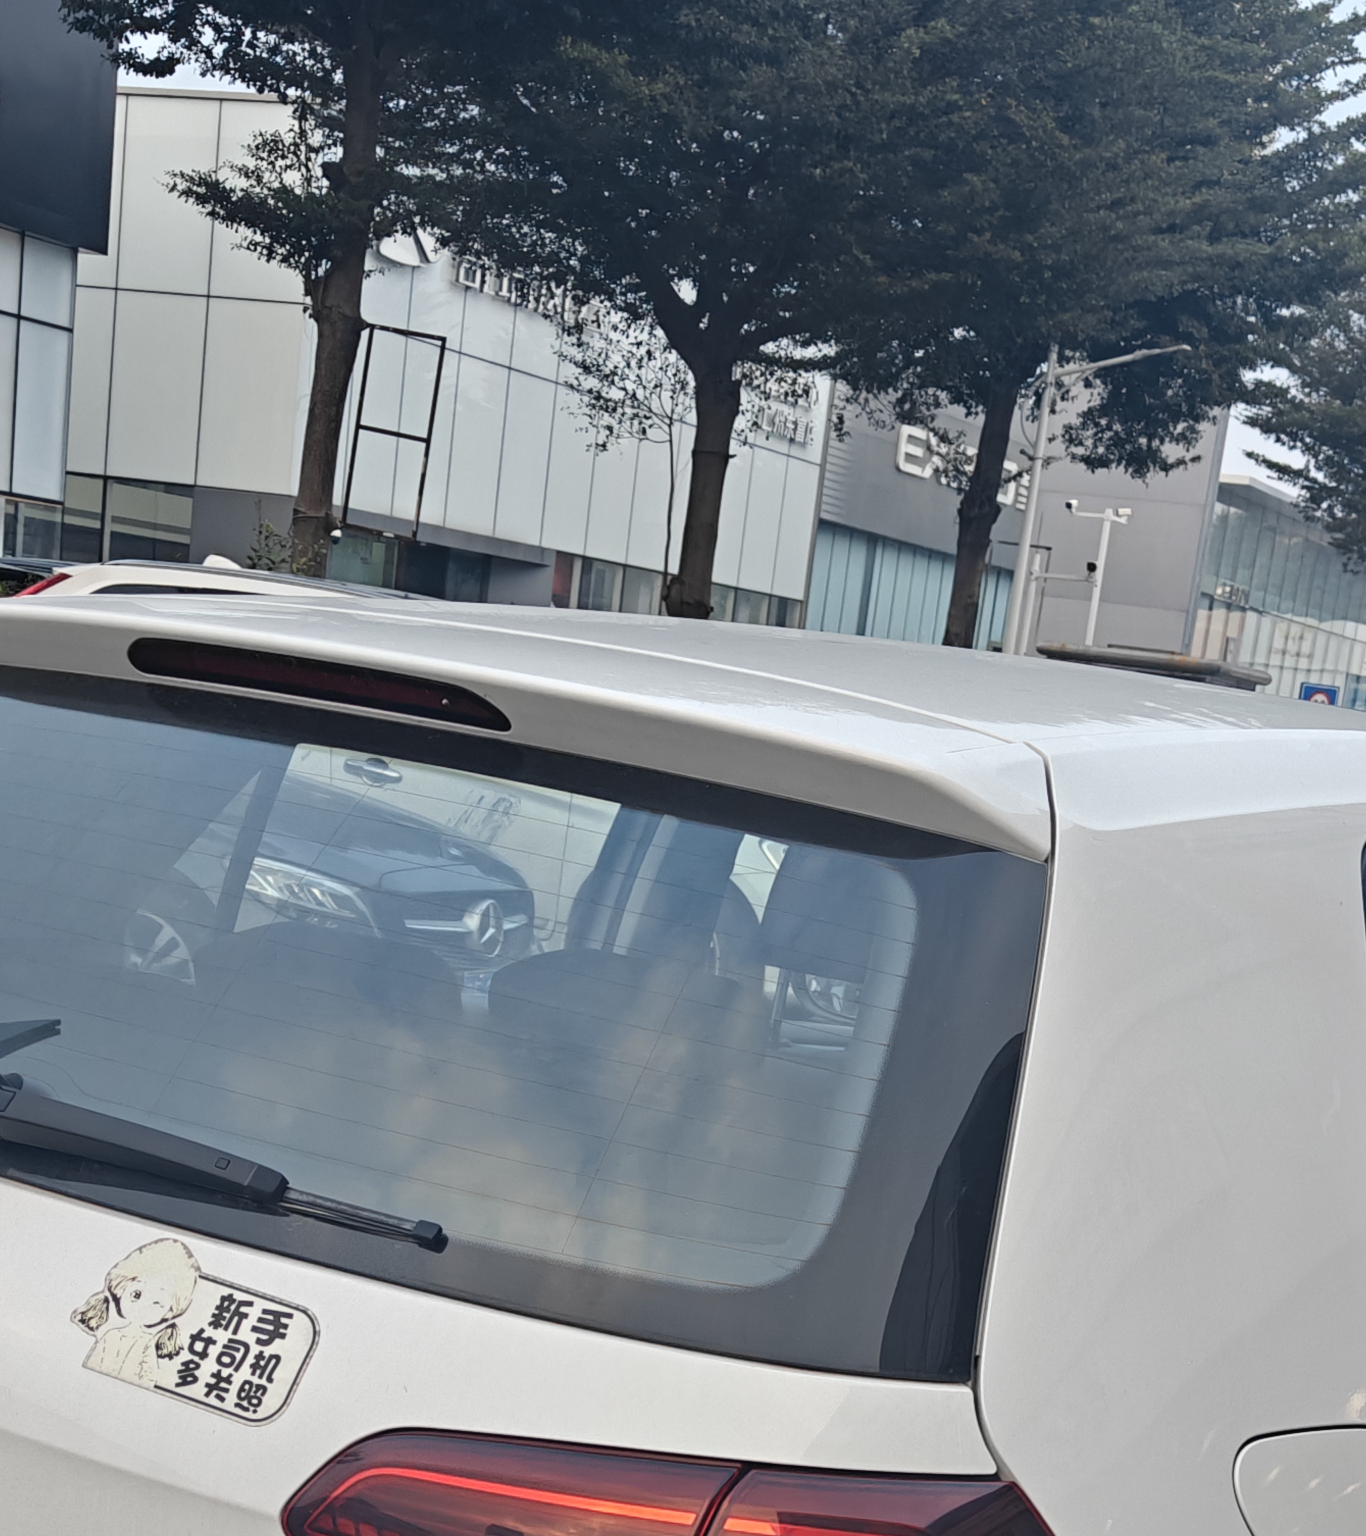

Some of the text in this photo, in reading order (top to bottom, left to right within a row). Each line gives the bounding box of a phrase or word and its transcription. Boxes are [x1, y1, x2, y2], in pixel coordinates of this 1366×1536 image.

[207, 1292, 294, 1347] 新手
[187, 1327, 282, 1384] 女司机
[174, 1359, 268, 1414] 多关照
